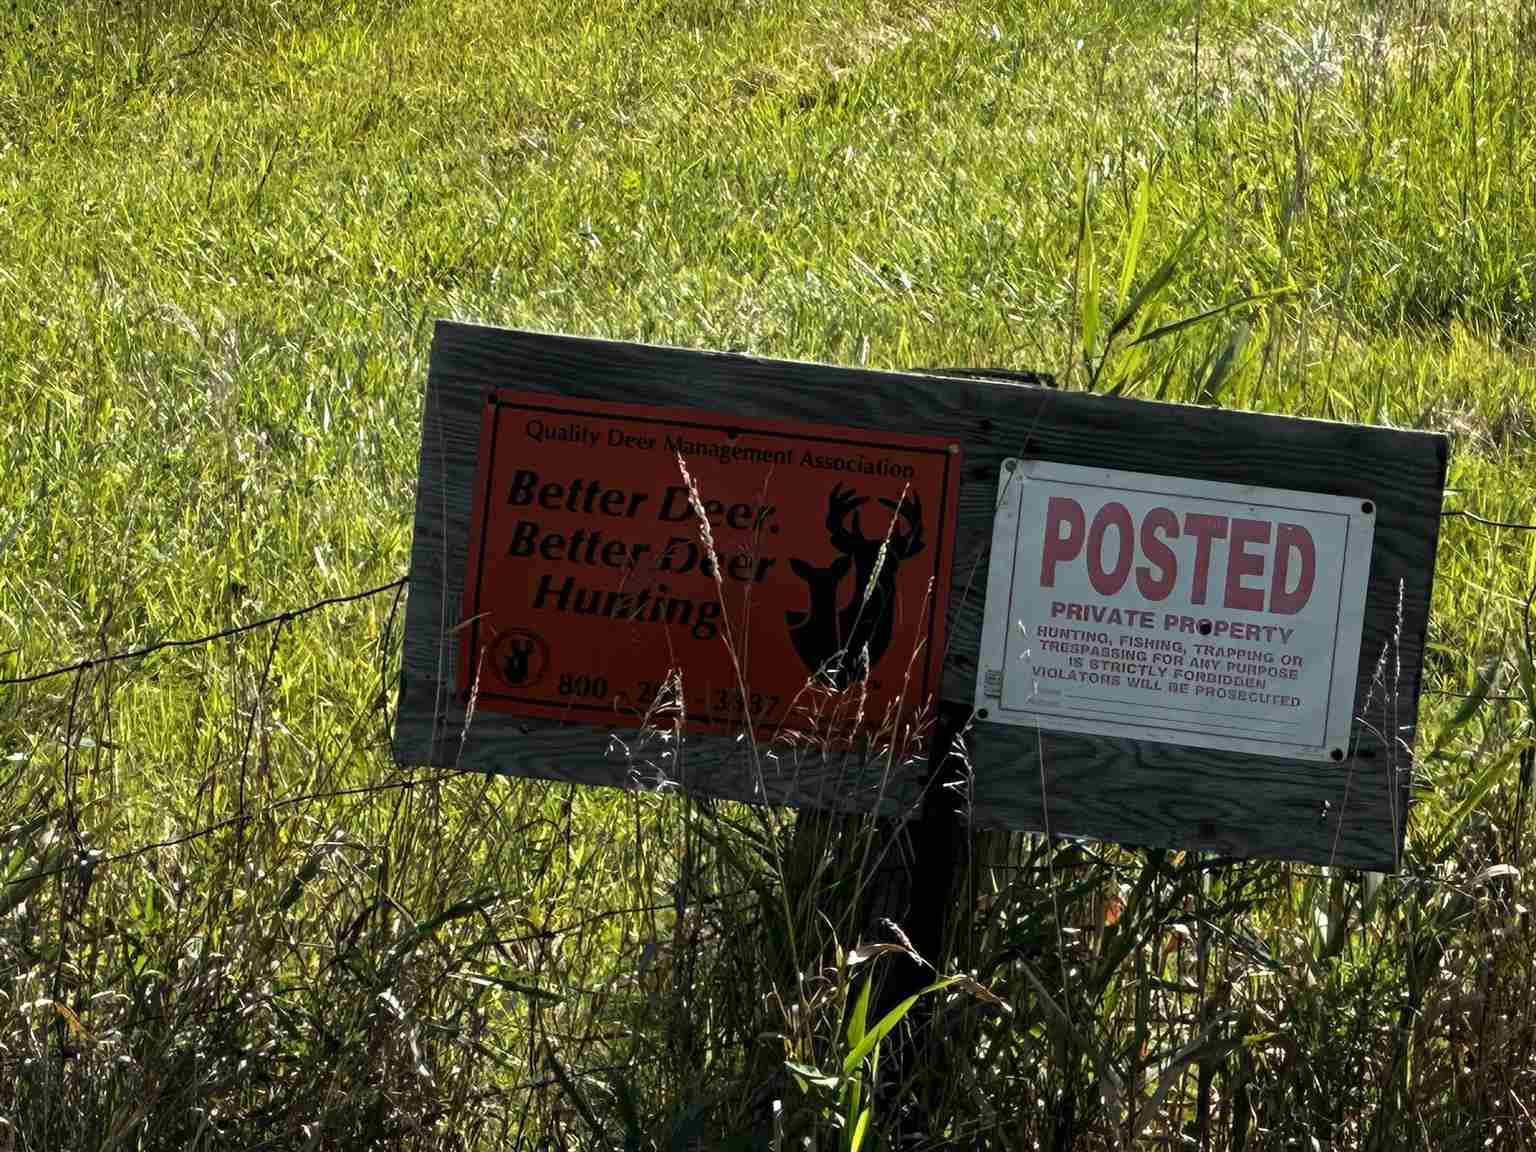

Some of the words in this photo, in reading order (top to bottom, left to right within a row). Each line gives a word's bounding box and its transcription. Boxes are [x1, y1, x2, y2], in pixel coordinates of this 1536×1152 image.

[525, 419, 600, 448] Quality
[607, 428, 657, 451] Deer
[663, 434, 794, 466] Management
[800, 453, 914, 480] Association
[507, 469, 648, 520] Better
[658, 485, 781, 535] Deer.
[508, 520, 650, 570] Better
[656, 536, 775, 586] Deer
[1039, 496, 1316, 616] POSTED
[532, 574, 723, 641] Hunting
[1050, 601, 1156, 629] PRIVATE
[1163, 614, 1295, 645] PROPERTY
[1036, 625, 1113, 646] HUNTING,
[1120, 635, 1187, 655] FISHING,
[1194, 644, 1274, 664] TRAPPING
[1280, 655, 1304, 668] OR
[1039, 640, 1147, 663] TRESPASSING
[1152, 653, 1185, 667] FOR
[1190, 658, 1220, 671] ANY
[1226, 661, 1299, 681] PURPOSE
[558, 674, 608, 699] 800
[1032, 666, 1121, 687] VIOLATORS
[1127, 677, 1163, 692] WILL
[1168, 682, 1190, 695] BE
[1195, 685, 1301, 708] PROSECUTED
[1068, 656, 1083, 668] IS
[1089, 660, 1168, 678] STRICTLY
[1173, 669, 1267, 690] FORBIDDEN
